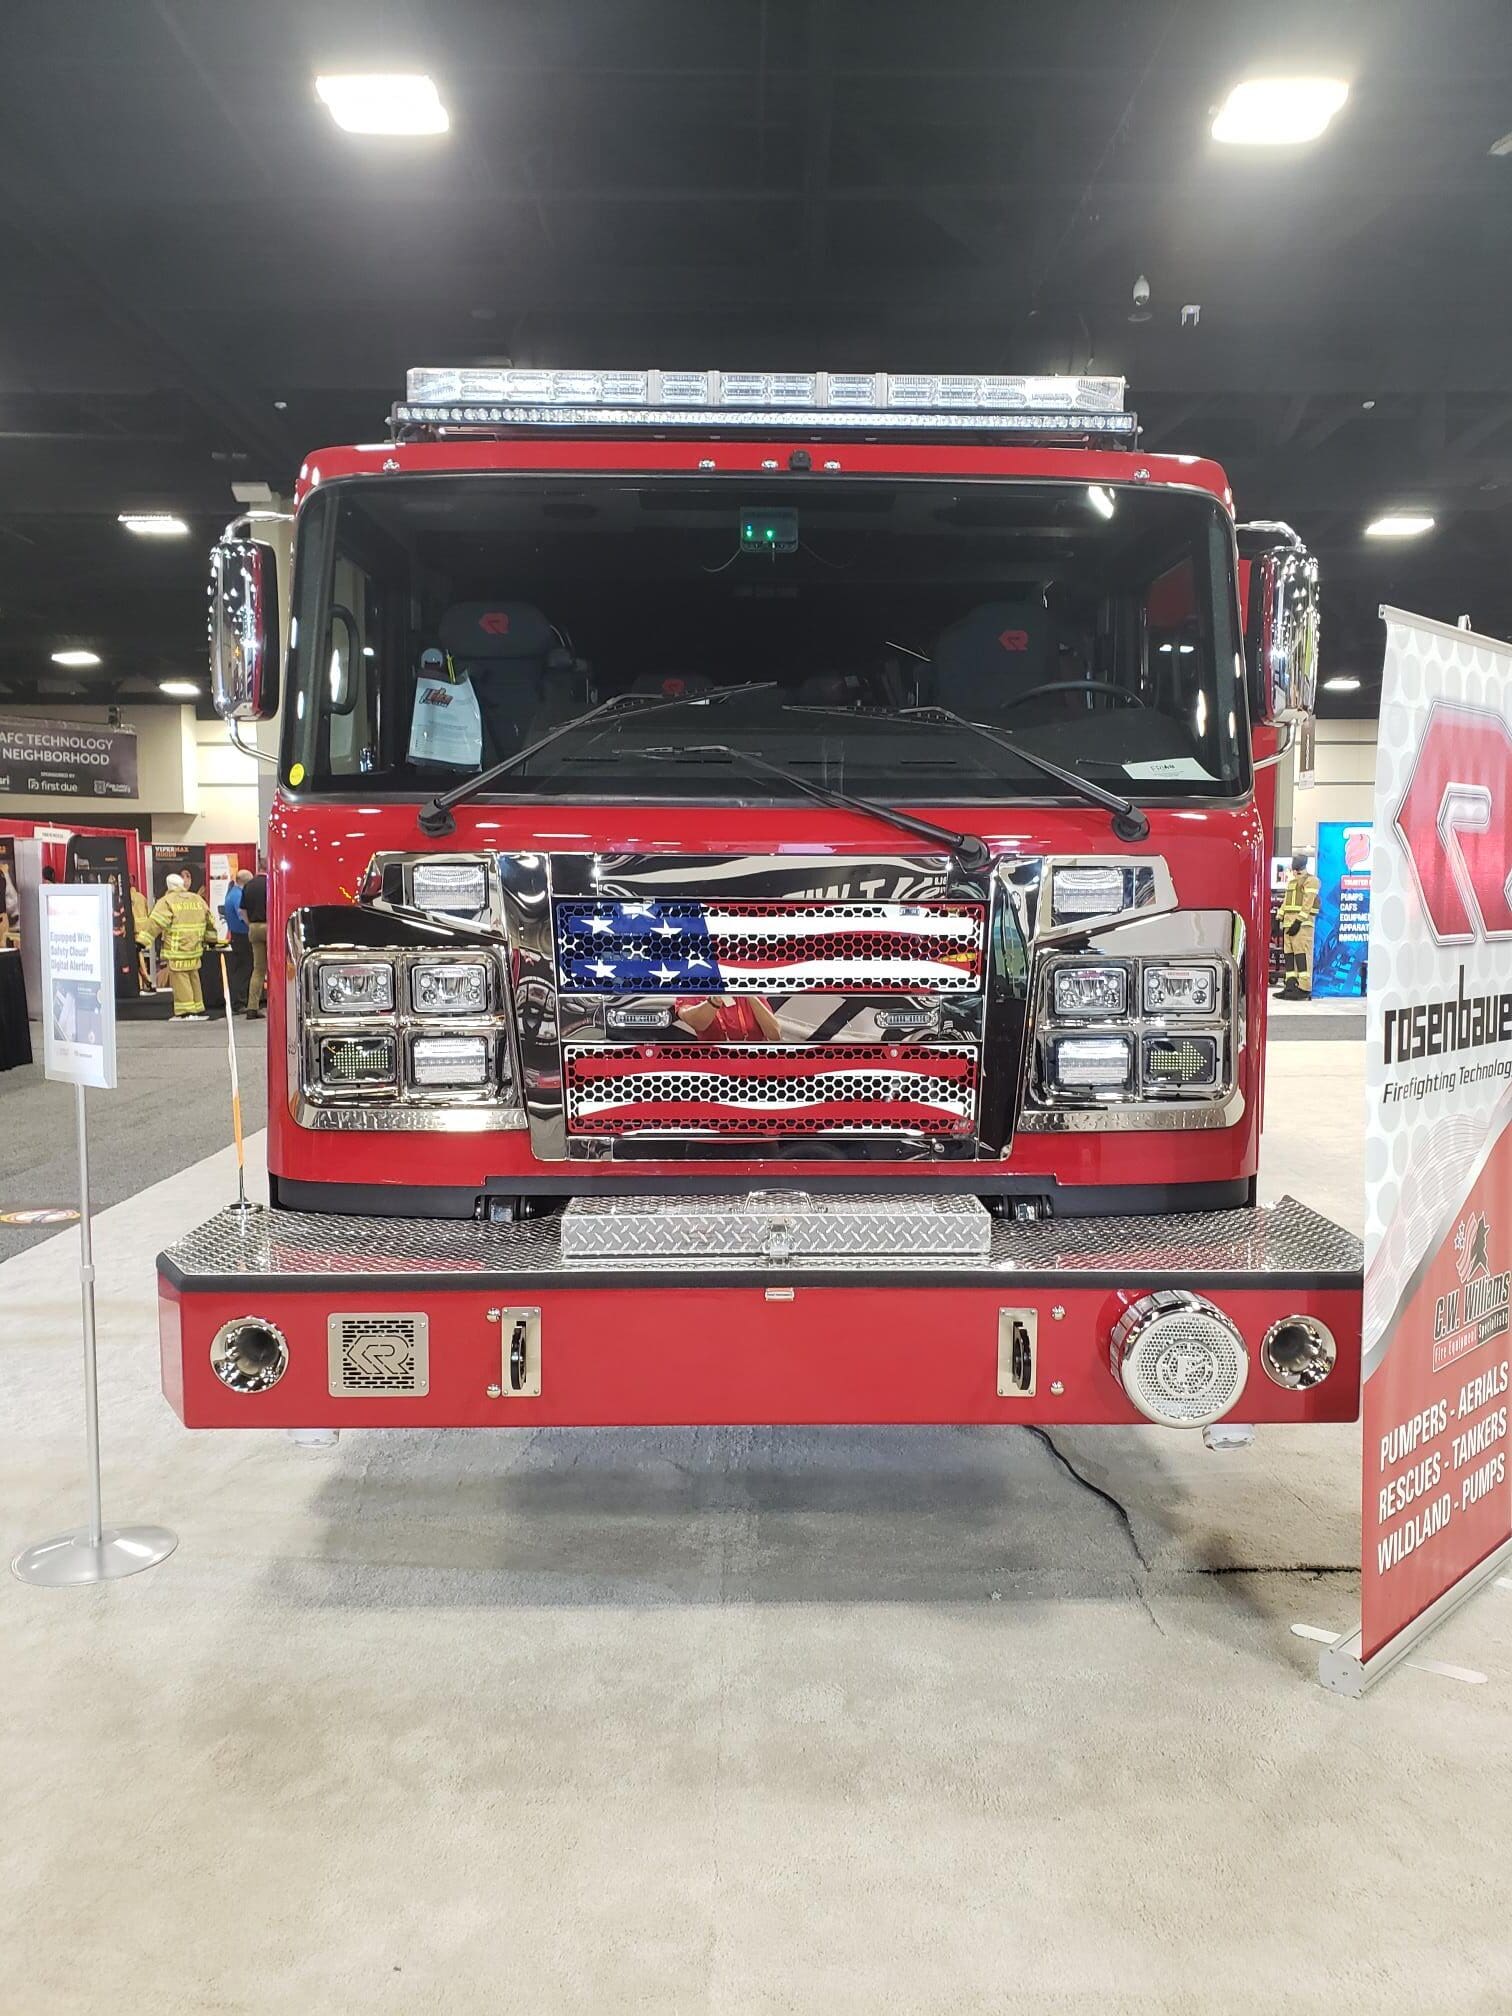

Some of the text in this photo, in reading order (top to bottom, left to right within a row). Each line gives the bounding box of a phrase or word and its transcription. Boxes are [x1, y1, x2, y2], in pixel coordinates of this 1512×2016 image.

[27, 734, 113, 750] TECHNOLOGY
[2, 748, 110, 765] NEIGHBORHOOD
[41, 781, 78, 792] first due
[1340, 892, 1364, 902] PUMPS
[1340, 903, 1358, 911] CAFS
[50, 931, 91, 944] Equipped With
[51, 945, 68, 958] Safety
[51, 959, 93, 974] Digital Alerting
[1383, 1072, 1456, 1104] Firefighting
[1463, 1270, 1511, 1325] Williams
[1435, 1310, 1508, 1363] Fire Equipment Specialists
[1380, 1398, 1448, 1473] PUMPERS
[1457, 1360, 1509, 1421] AERIALS
[1378, 1451, 1441, 1525] RESCUES
[1452, 1406, 1507, 1471] TANKERS
[1377, 1492, 1451, 1576] WILDLAND
[1462, 1452, 1506, 1512] PUMPS
